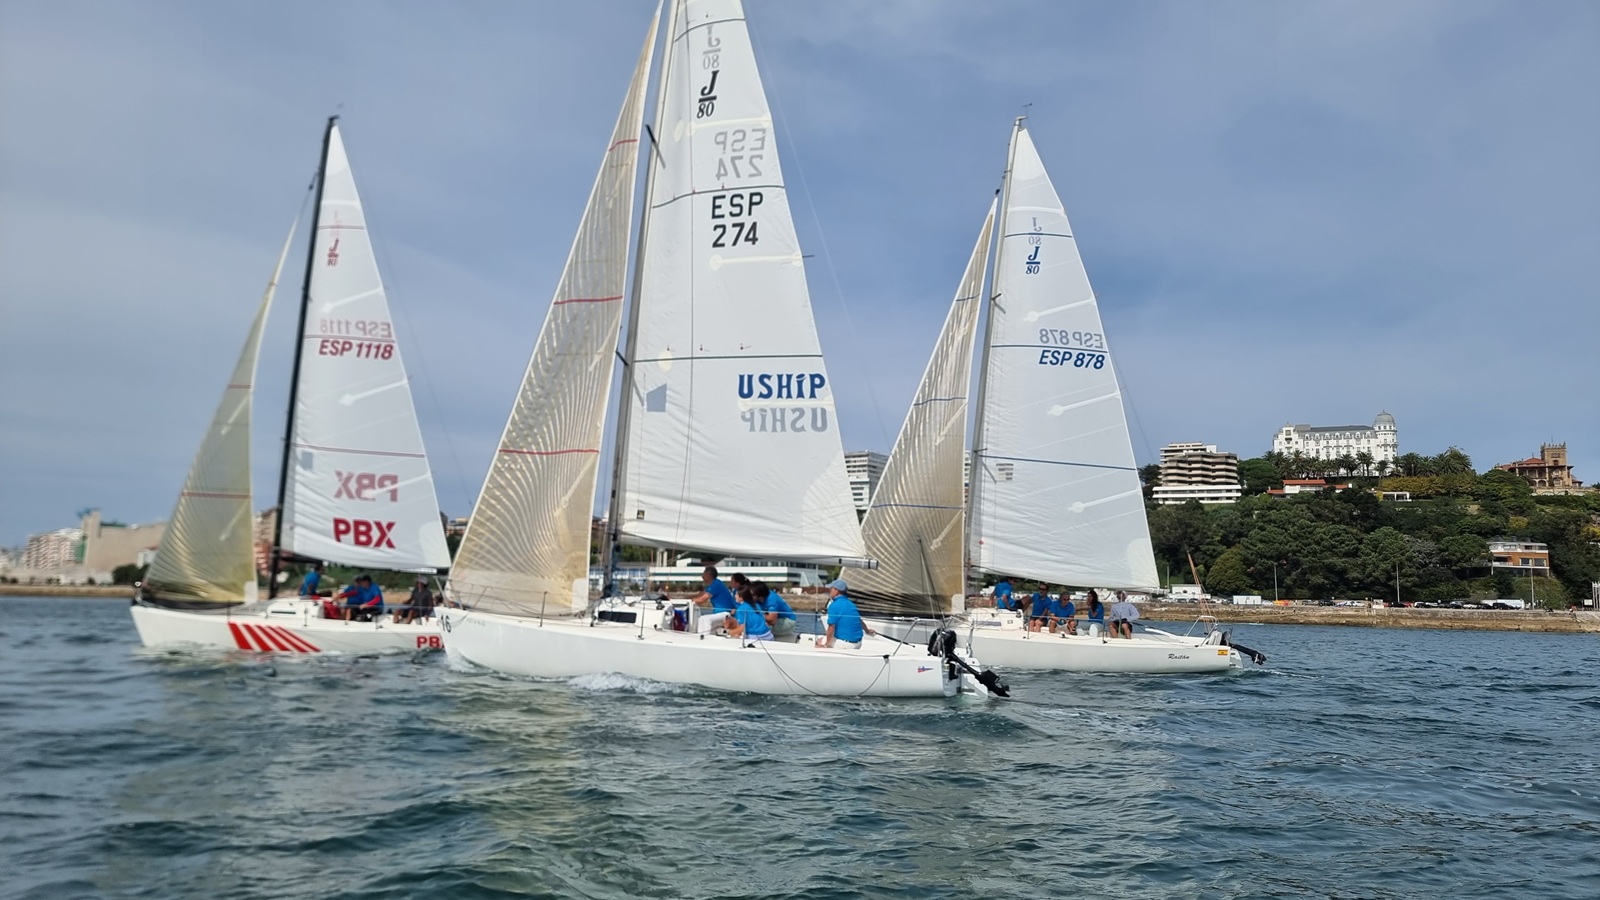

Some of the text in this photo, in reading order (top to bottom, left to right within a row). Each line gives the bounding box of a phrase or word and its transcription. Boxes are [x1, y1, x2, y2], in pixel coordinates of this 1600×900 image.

[700, 70, 719, 96] J
[696, 102, 715, 119] 80
[711, 192, 764, 219] ESP
[712, 222, 759, 248] 274
[1027, 246, 1041, 261] J
[1025, 265, 1040, 275] 80
[319, 340, 394, 360] ESP 1118
[1039, 350, 1105, 370] ESP 878
[333, 517, 397, 549] PBX
[440, 615, 452, 633] 16
[417, 636, 444, 648] PB
